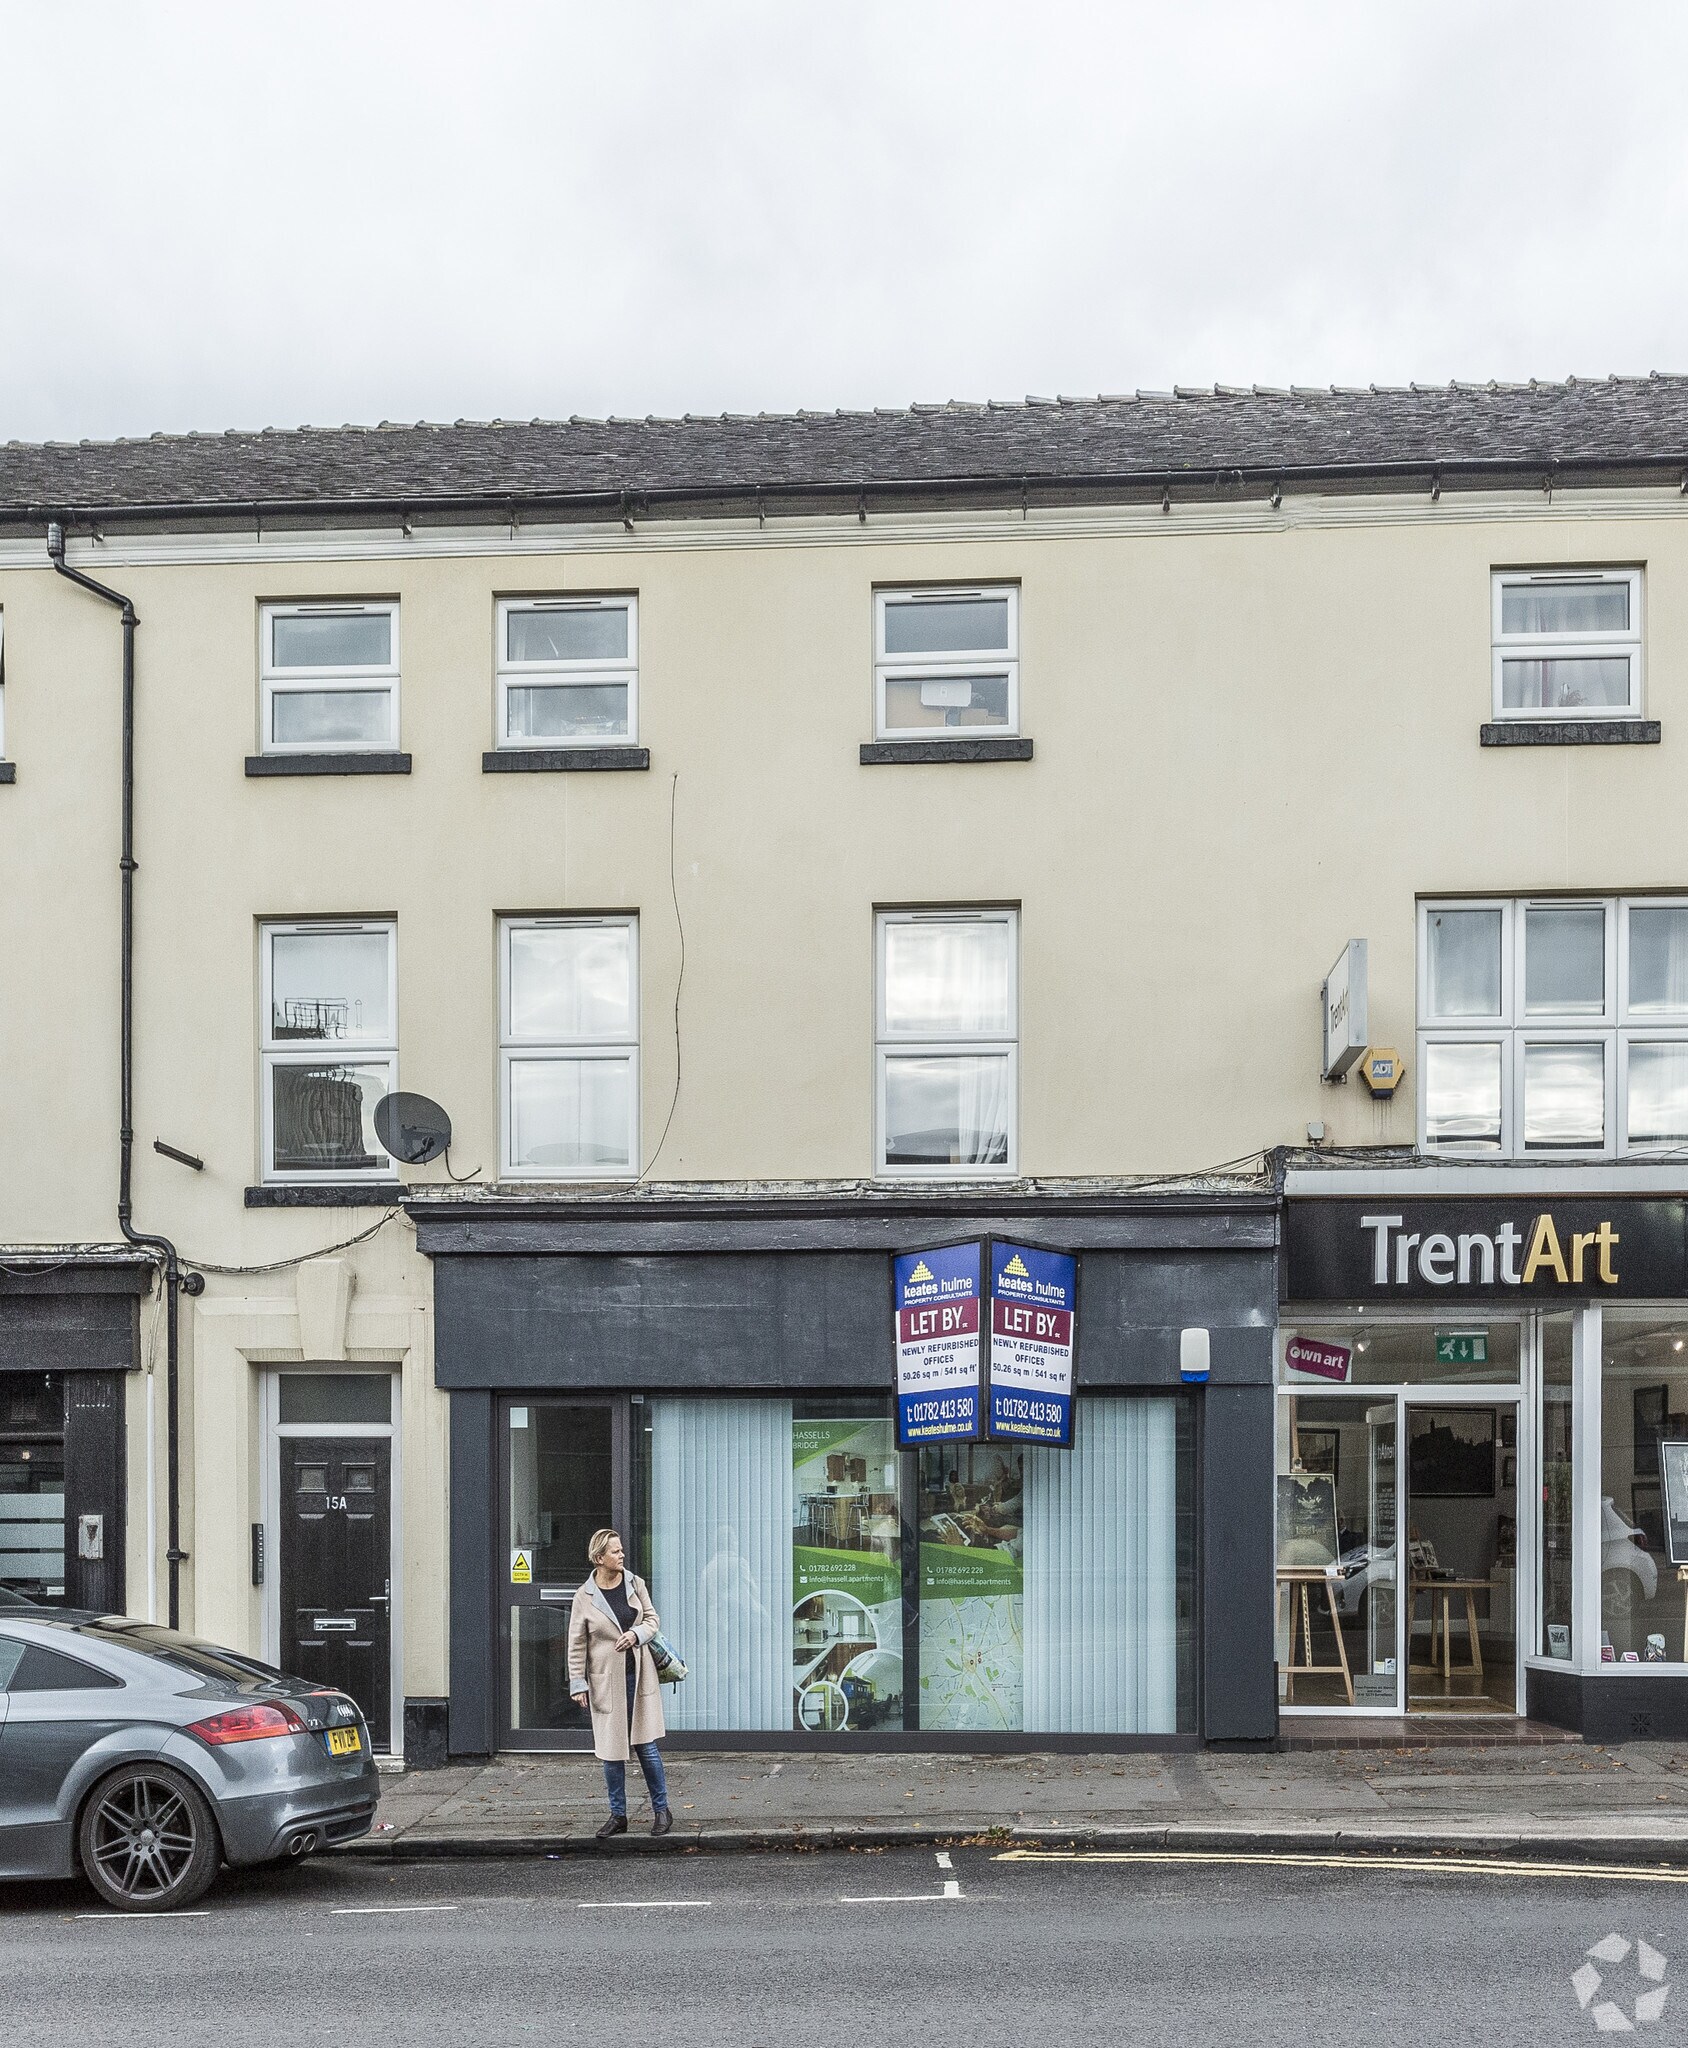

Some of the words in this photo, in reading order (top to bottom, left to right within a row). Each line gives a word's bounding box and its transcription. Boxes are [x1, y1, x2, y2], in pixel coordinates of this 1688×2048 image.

[1372, 1063, 1393, 1074] ADT
[1360, 1214, 1619, 1284] TrentArt
[904, 1283, 938, 1299] keates
[941, 1277, 973, 1293] hulme
[998, 1273, 1033, 1293] keates
[1036, 1280, 1065, 1298] hulme
[904, 1297, 932, 1306] PROPERTY
[933, 1290, 973, 1301] CONSULTANTS
[997, 1289, 1027, 1299] PROPERTY
[1027, 1294, 1065, 1306] CONSULTANTS
[910, 1310, 939, 1336] LET
[942, 1305, 964, 1331] BY
[1004, 1306, 1033, 1333] LET
[1036, 1312, 1057, 1337] BY
[902, 1345, 926, 1357] NEWLY
[928, 1338, 979, 1353] REFURBISHED
[993, 1337, 1018, 1349] NEWLY
[1019, 1341, 1069, 1357] REFURBISHED
[923, 1354, 954, 1366] OFFICES
[1014, 1353, 1045, 1366] OFFICES
[1323, 1354, 1344, 1369] art
[902, 1370, 921, 1381] 50.26
[922, 1371, 931, 1380] sq
[932, 1369, 939, 1377] m
[944, 1366, 957, 1376] 541
[960, 1367, 968, 1375] sq
[992, 1362, 1011, 1374] 50.26
[1013, 1367, 1022, 1376] sq
[1023, 1368, 1030, 1376] m
[1035, 1369, 1047, 1379] 541
[1049, 1372, 1058, 1382] sq
[913, 1401, 939, 1422] 01782
[940, 1399, 956, 1419] 413
[957, 1397, 974, 1418] 580
[1003, 1397, 1028, 1419] 01782
[1029, 1401, 1045, 1421] 413
[1046, 1403, 1062, 1424] 580
[793, 1431, 831, 1439] HASSELLS
[907, 1420, 973, 1437] www.keateshulme.co.uk
[995, 1420, 1062, 1438] www.keateshulme.co.uk
[793, 1441, 819, 1449] BRIDGE
[325, 1496, 347, 1510] 15A
[808, 1564, 830, 1572] 01782
[830, 1564, 843, 1572] 692
[936, 1566, 957, 1574] 01782
[957, 1566, 970, 1574] 692
[970, 1566, 984, 1574] 228
